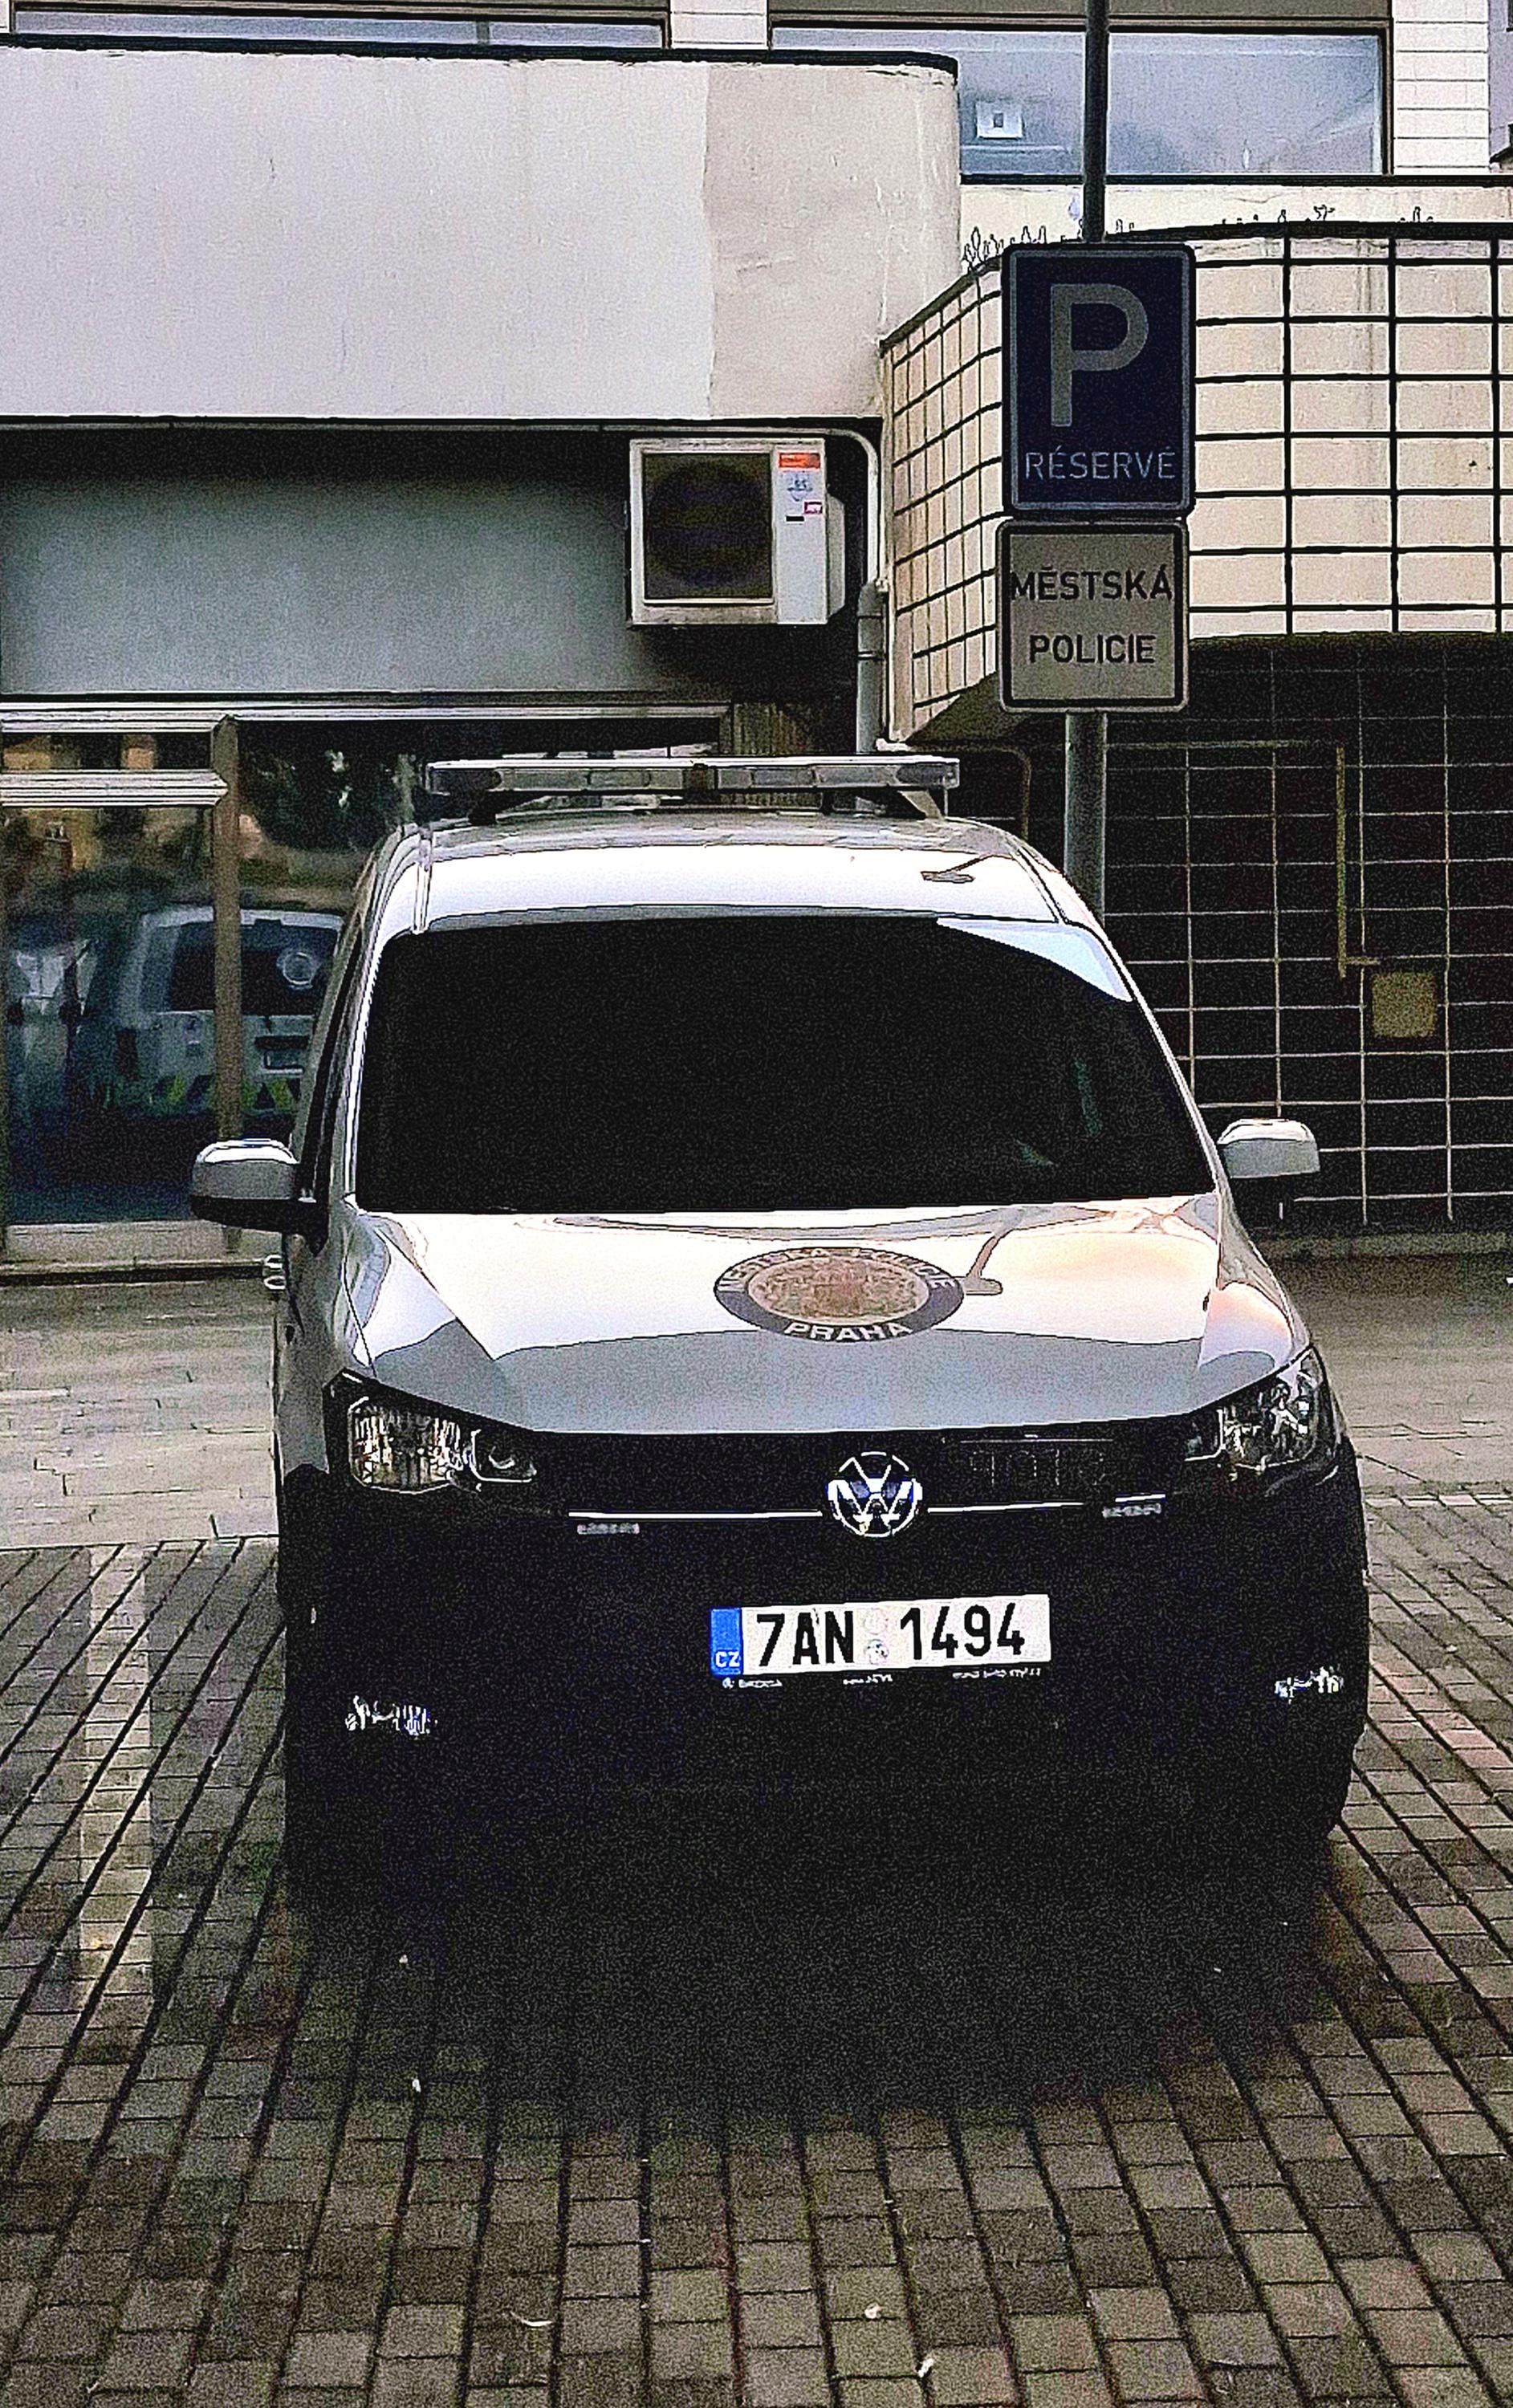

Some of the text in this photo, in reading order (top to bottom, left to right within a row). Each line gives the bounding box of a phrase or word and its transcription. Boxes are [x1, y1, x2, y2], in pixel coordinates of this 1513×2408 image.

[1051, 283, 1149, 427] P
[1024, 445, 1177, 481] RÉSERVÉ
[1011, 563, 1174, 601] MĚSTSKÁ
[1029, 633, 1157, 665] POLICIE
[783, 1322, 913, 1342] PRAHA
[756, 1602, 1026, 1667] 7AN 1494
[715, 1651, 740, 1668] CZ
